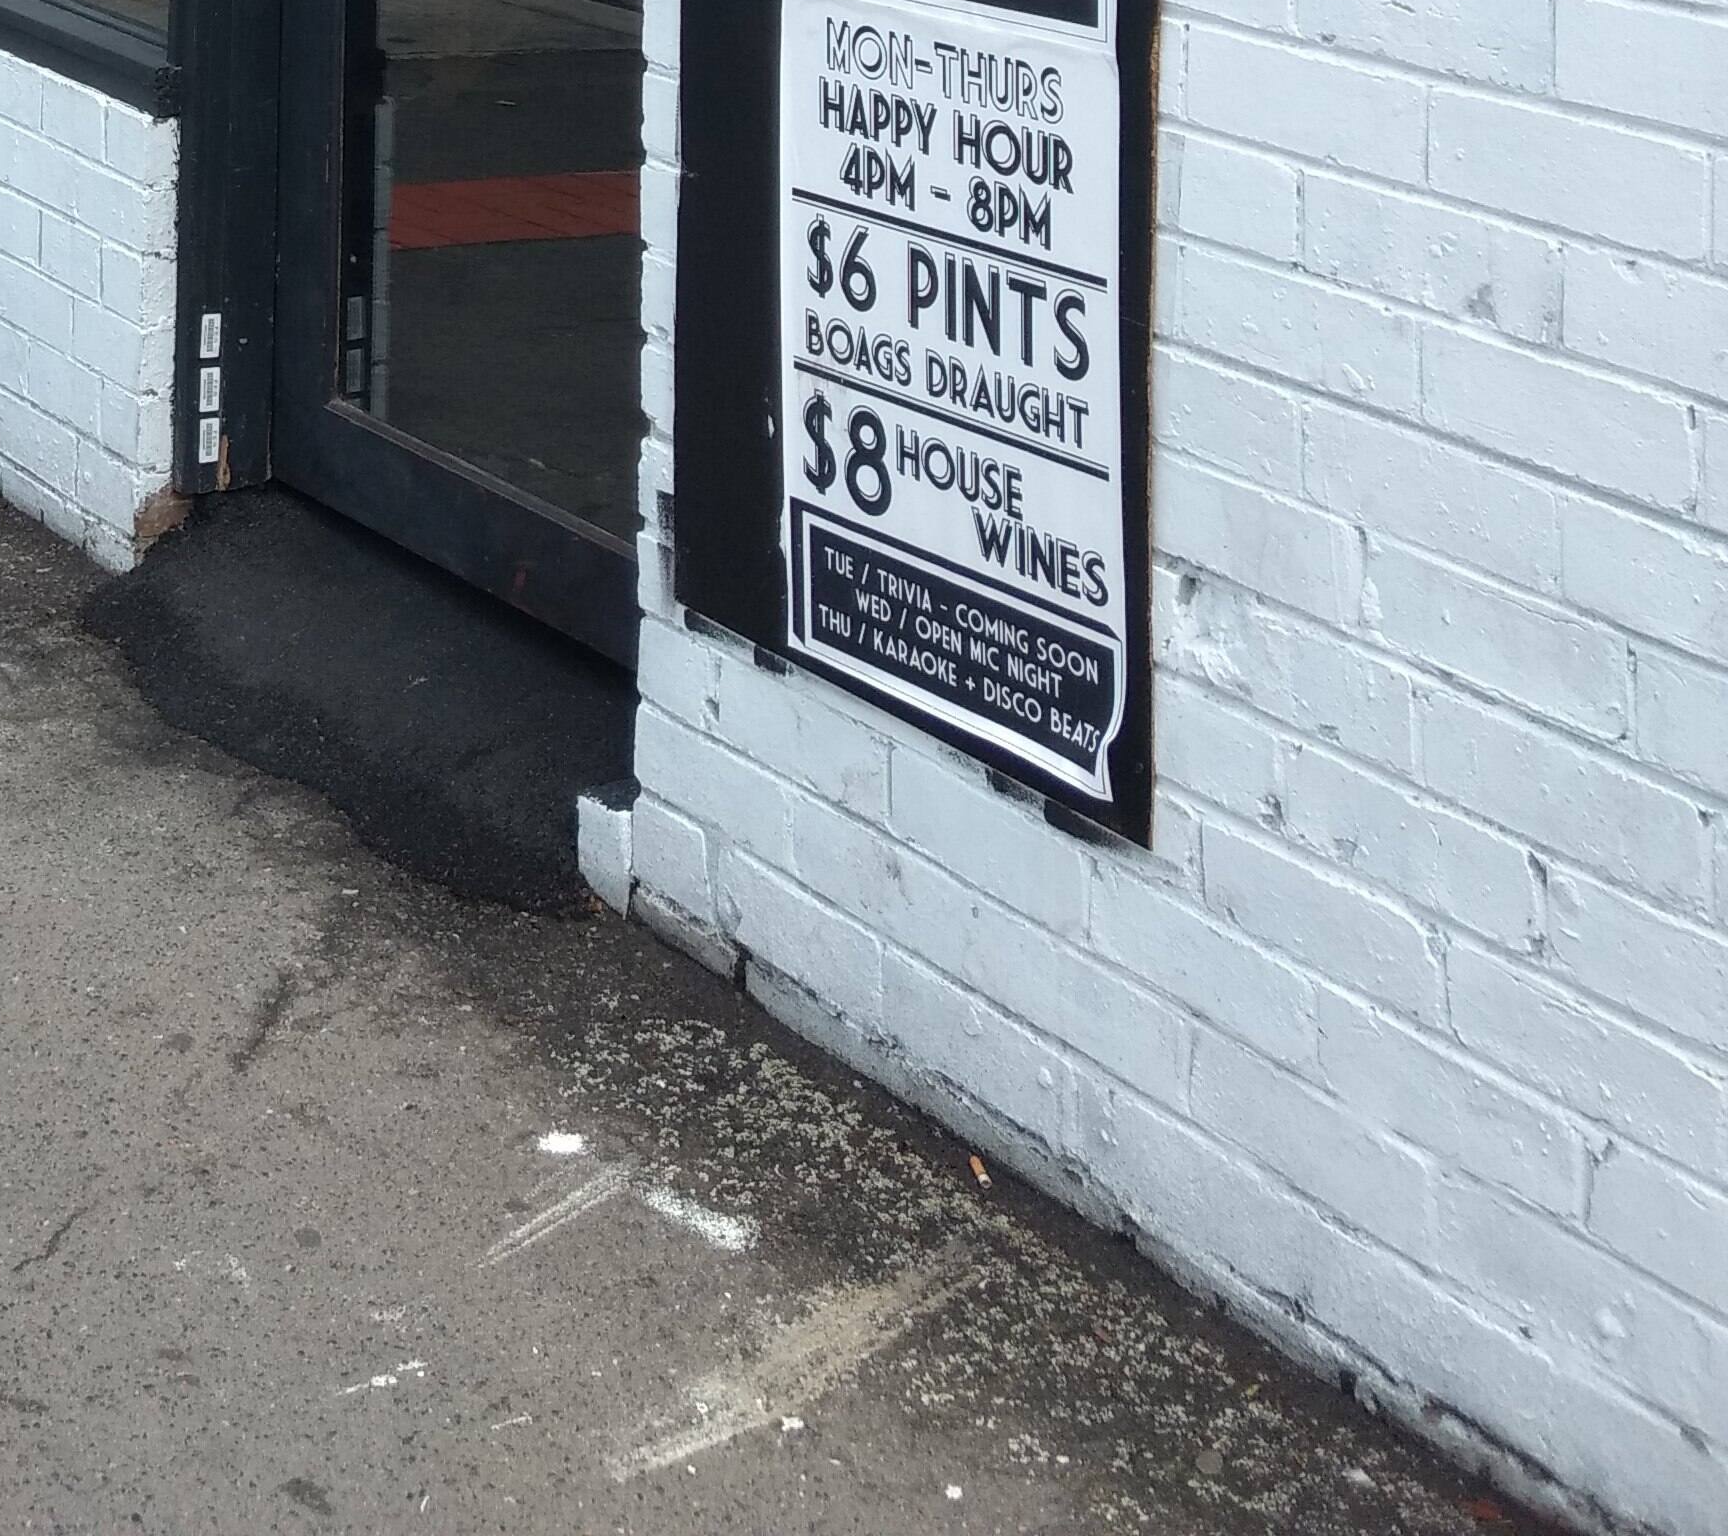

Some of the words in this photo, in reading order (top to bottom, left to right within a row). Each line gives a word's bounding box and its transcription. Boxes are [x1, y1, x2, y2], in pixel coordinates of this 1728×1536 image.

[825, 17, 1064, 124] MON-THURS
[818, 76, 937, 155] HAPPY
[953, 110, 1074, 195] HOUR
[840, 142, 917, 210] 4PM
[966, 175, 1052, 252] 8PM
[806, 215, 878, 314] $6
[906, 241, 1091, 380] PINTS
[805, 309, 912, 387] BOAGS
[925, 347, 1089, 449] DRAUGHT
[802, 391, 893, 517] $8
[896, 425, 1023, 520] HOUSE
[824, 546, 855, 580] TUE
[876, 566, 934, 612] TRIVIA
[955, 600, 1029, 655] COMING
[1036, 635, 1100, 684] SOON
[971, 505, 1109, 606] WINES
[818, 602, 853, 640] THU
[872, 629, 958, 690] KARAOKE
[983, 678, 1043, 727] DISCO
[1050, 707, 1101, 753] BEATS
[854, 589, 891, 626] WED
[915, 617, 962, 657] OPEN
[969, 641, 1000, 672] MIC
[1005, 654, 1064, 698] NIGHT
